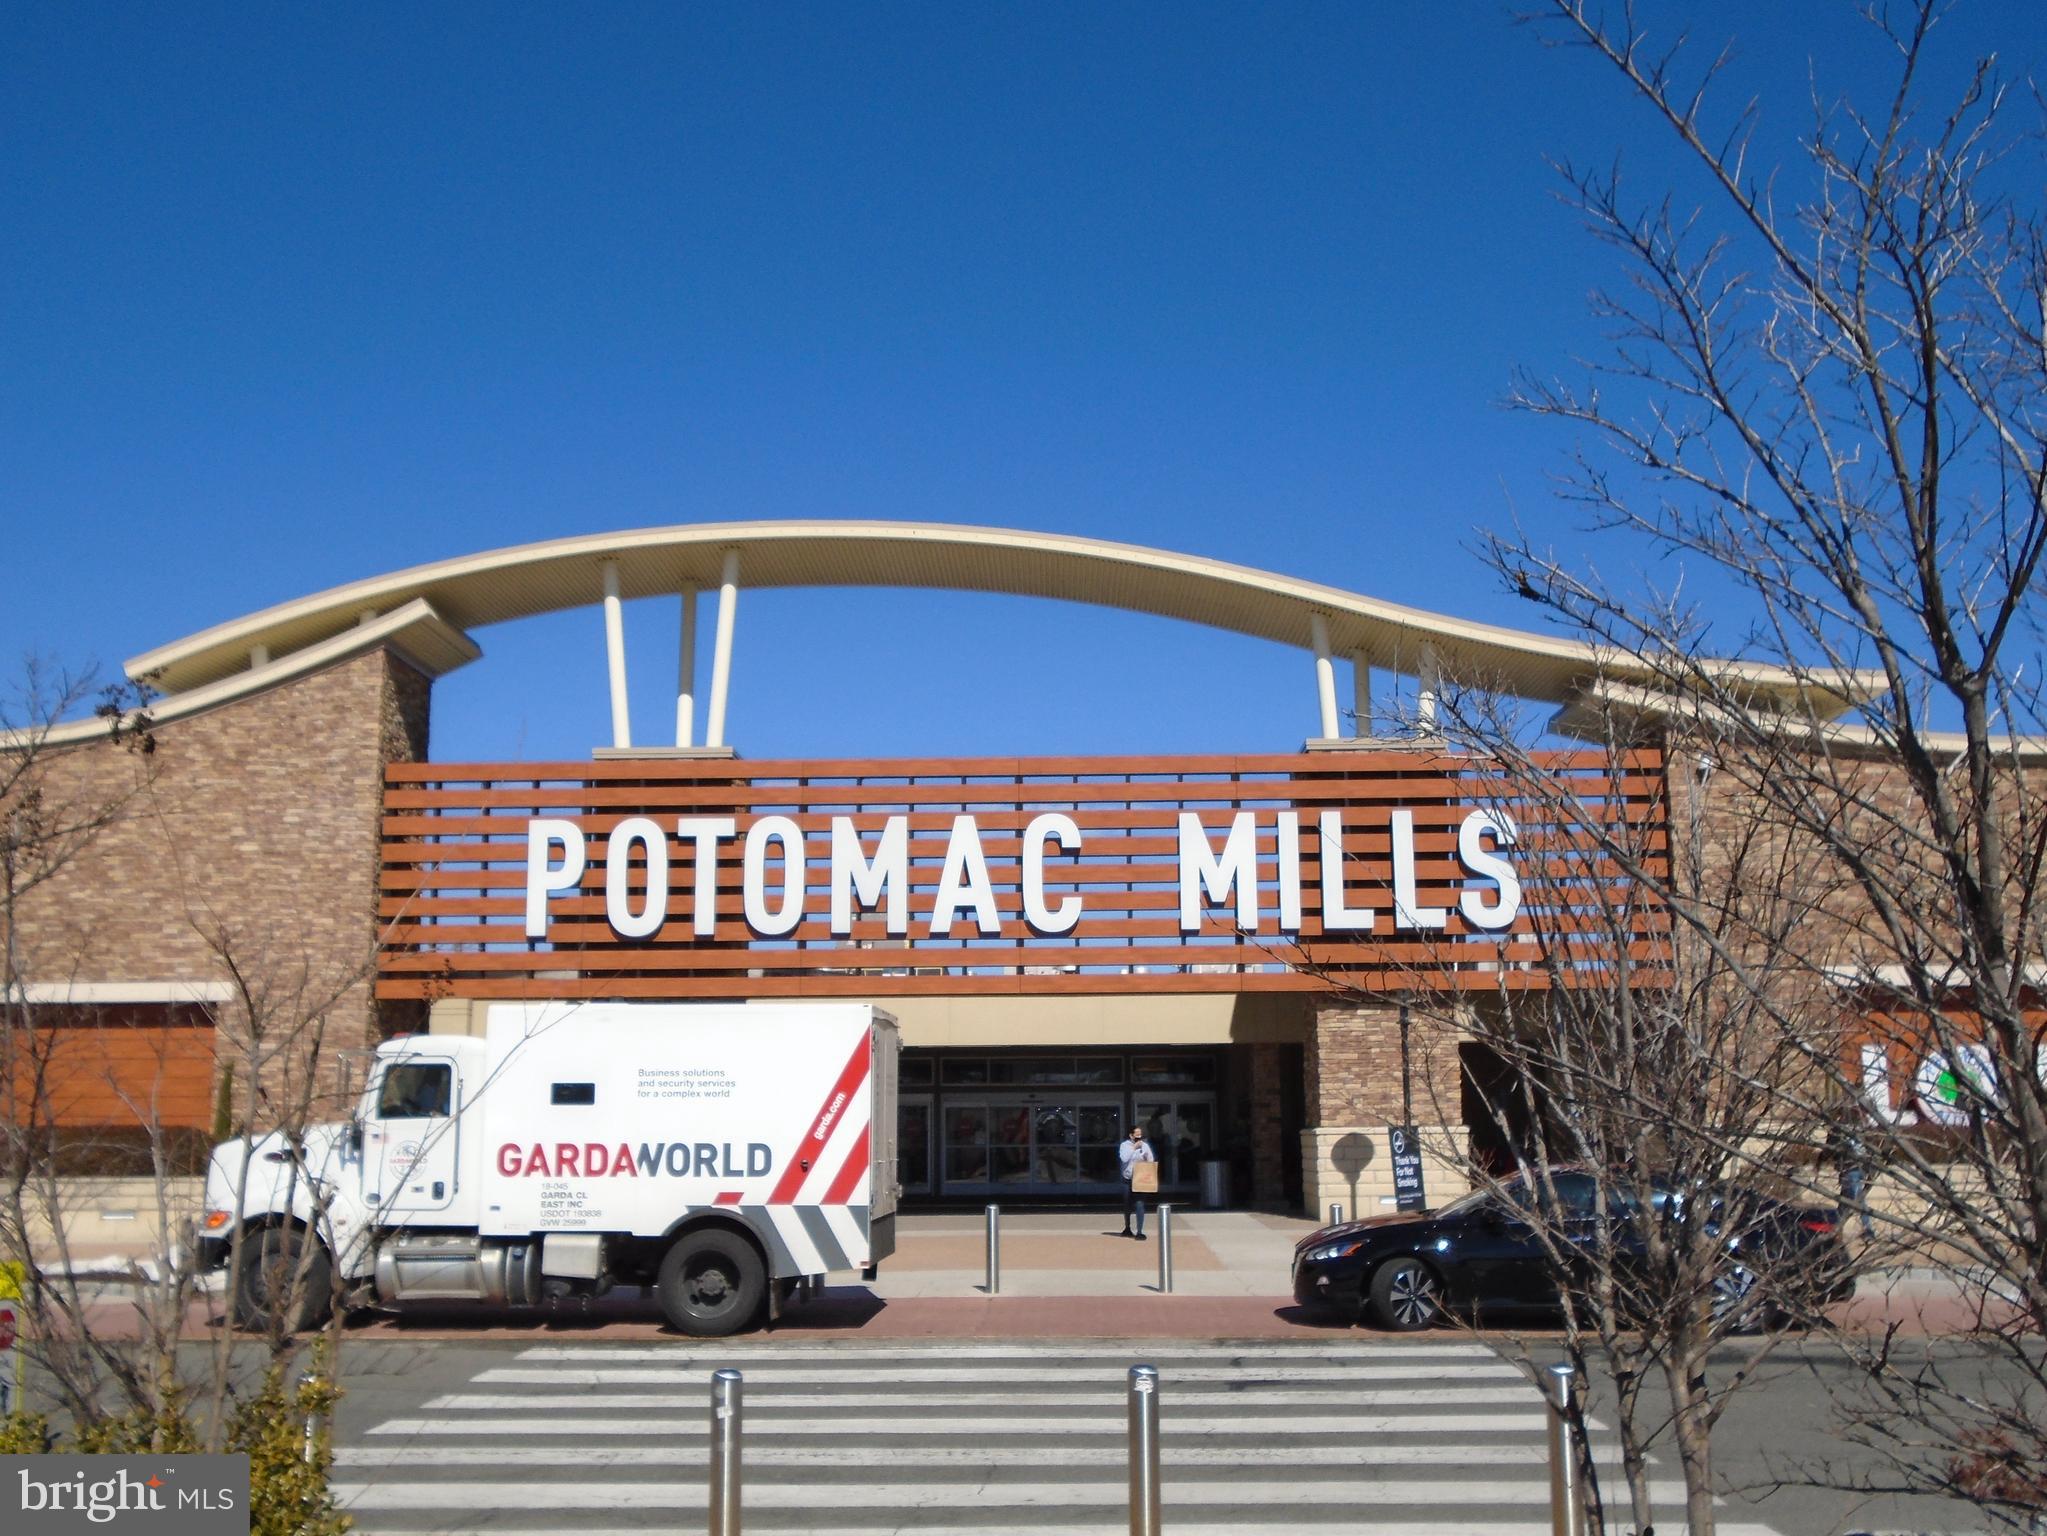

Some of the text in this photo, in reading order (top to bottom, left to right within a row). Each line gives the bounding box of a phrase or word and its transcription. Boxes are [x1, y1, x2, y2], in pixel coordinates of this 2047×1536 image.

[526, 809, 1521, 938] POTOMAC MILLS
[638, 1068, 726, 1077] Business solutions
[638, 1079, 655, 1087] and
[658, 1079, 695, 1089] security
[637, 1090, 651, 1098] for
[661, 1090, 701, 1099] complex
[704, 1090, 730, 1098] world
[814, 1091, 846, 1140] garda.com
[496, 1142, 772, 1178] GARDAWORLD
[1395, 1155, 1419, 1166] Thank You
[1396, 1167, 1414, 1177] For Not
[1397, 1177, 1418, 1188] Smoking
[541, 1191, 588, 1199] GARDA CL
[540, 1200, 583, 1208] EAST INC
[540, 1209, 570, 1217] USDOT
[540, 1218, 560, 1227] GVW
